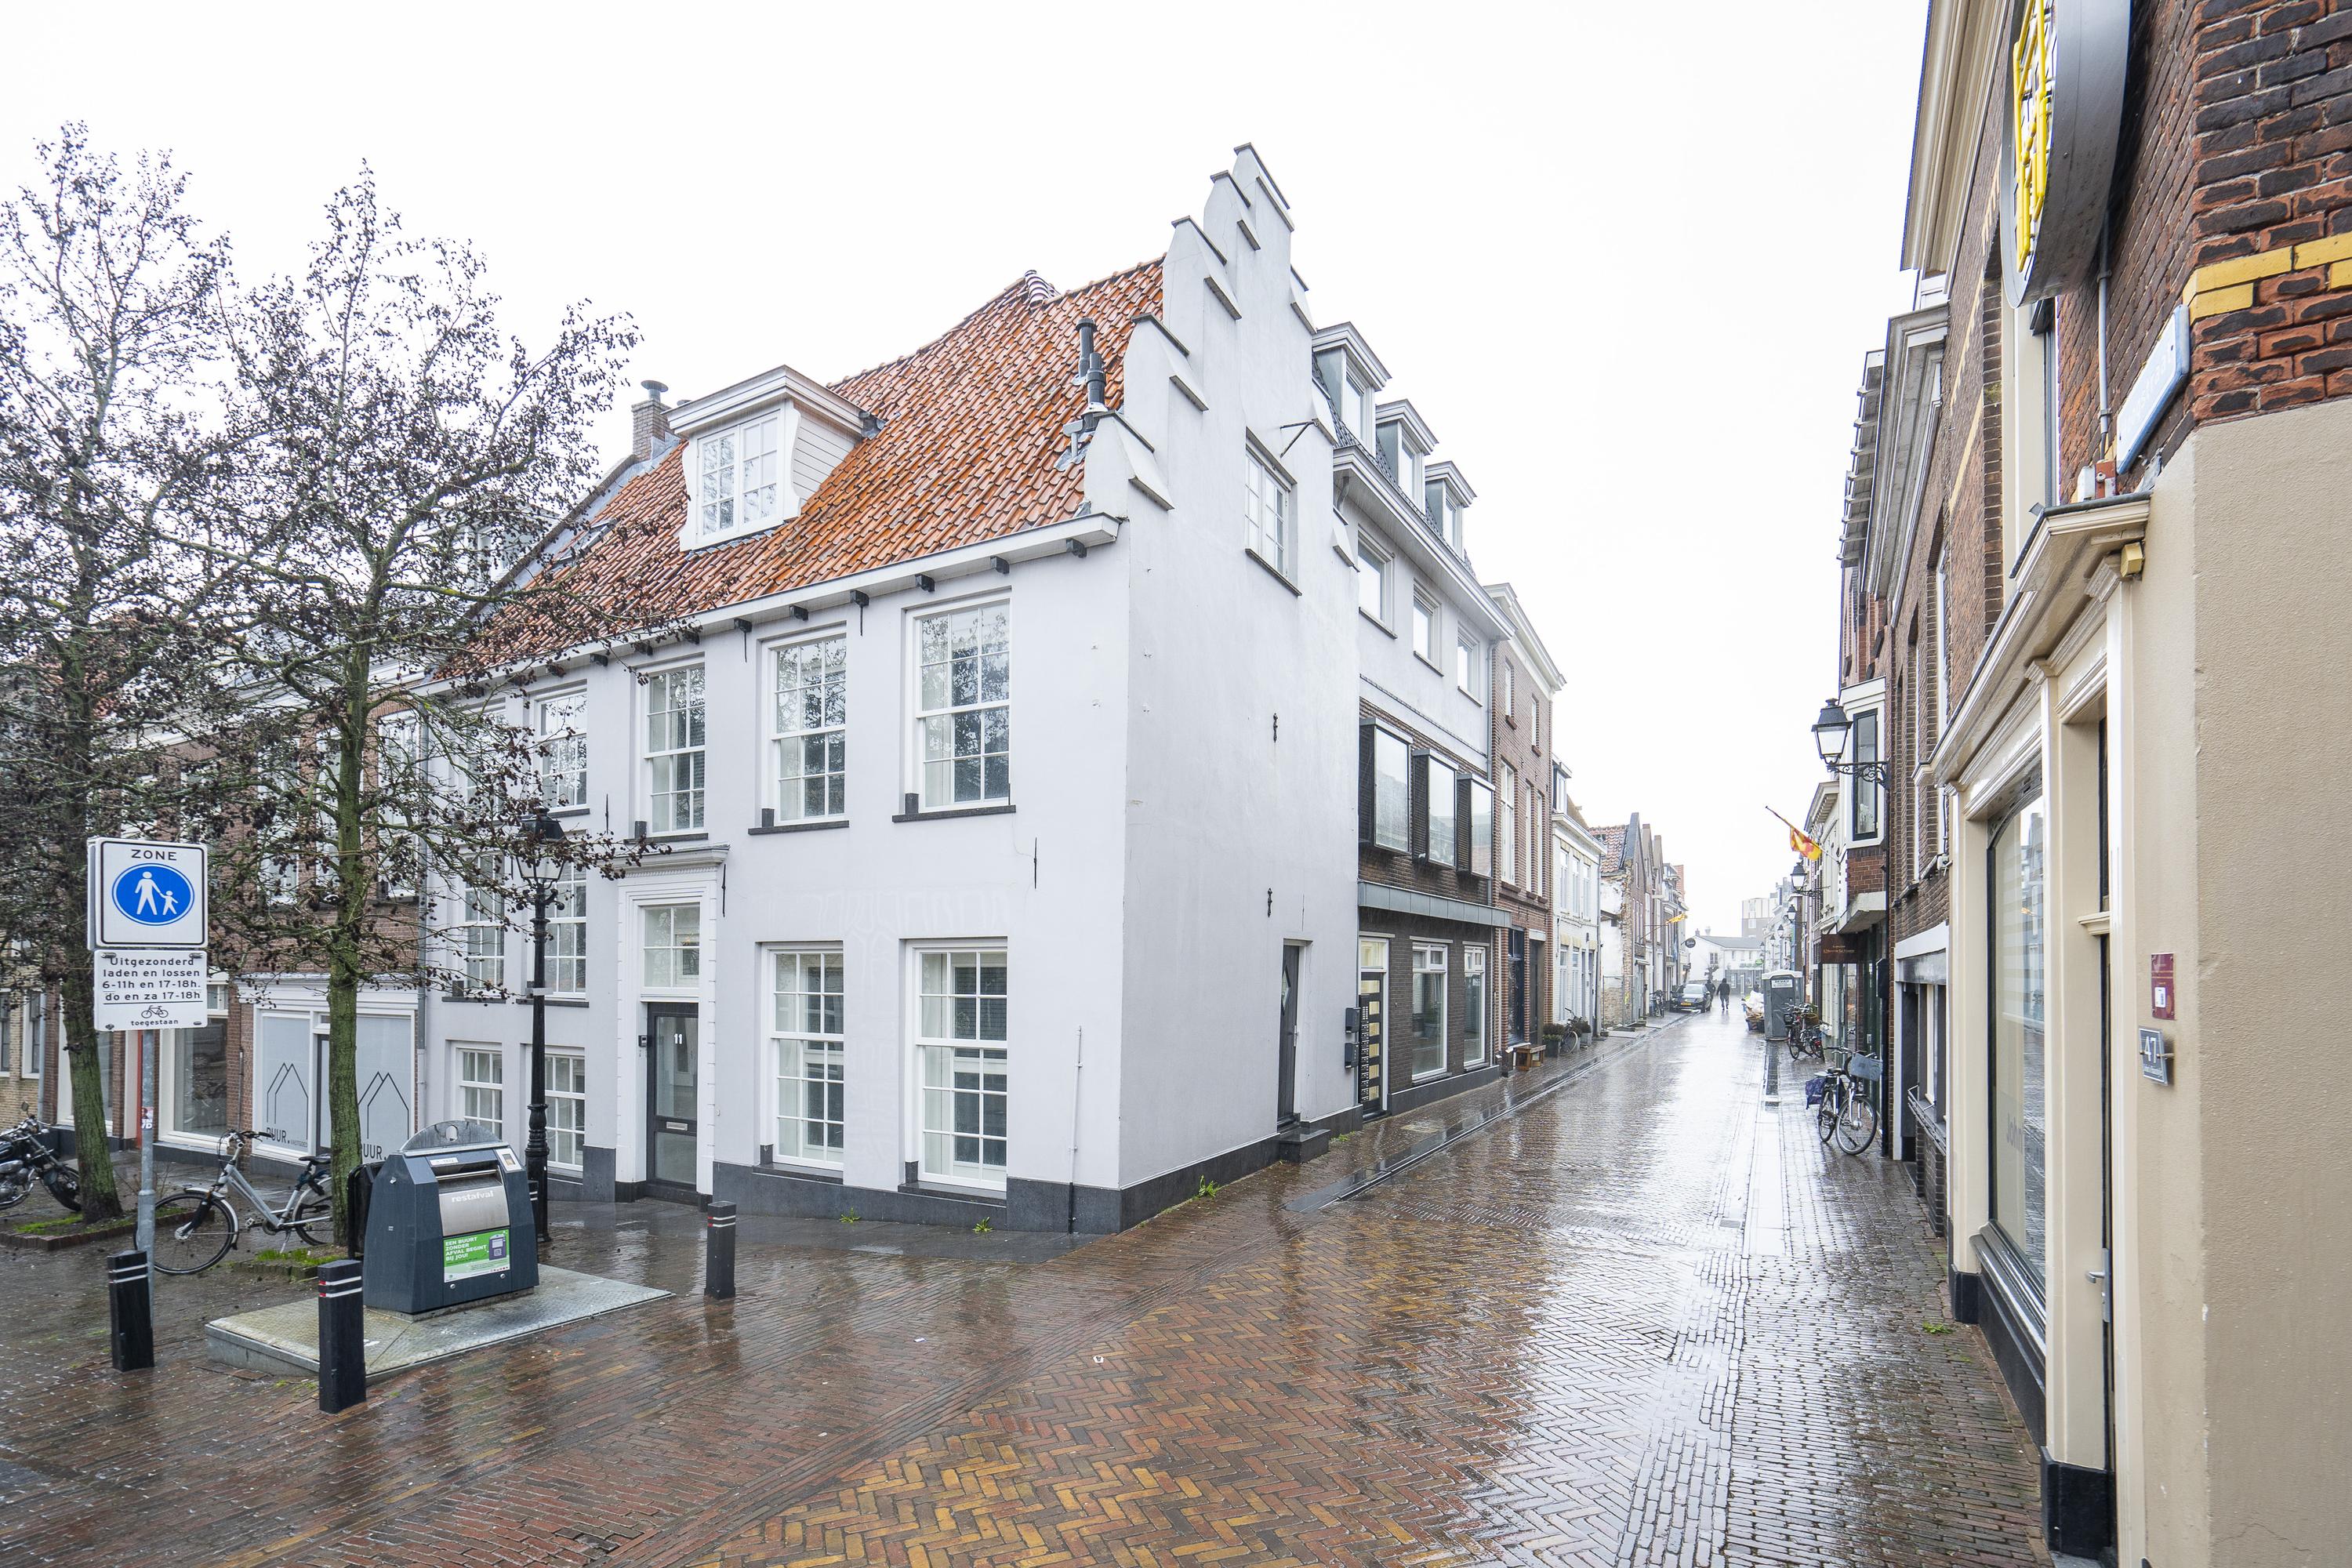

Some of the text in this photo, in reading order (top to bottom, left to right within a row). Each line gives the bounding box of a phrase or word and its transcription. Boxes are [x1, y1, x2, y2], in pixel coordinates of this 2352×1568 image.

[131, 848, 177, 861] ZONE
[110, 957, 194, 967] Uitgezonderd
[106, 993, 120, 1001] do
[163, 991, 201, 1000] 17-18h
[674, 1033, 682, 1044] 11
[2144, 1036, 2157, 1063] 47
[361, 1143, 387, 1160] UUR.
[452, 1190, 494, 1203] restafval
[466, 1244, 487, 1253] BEGINT
